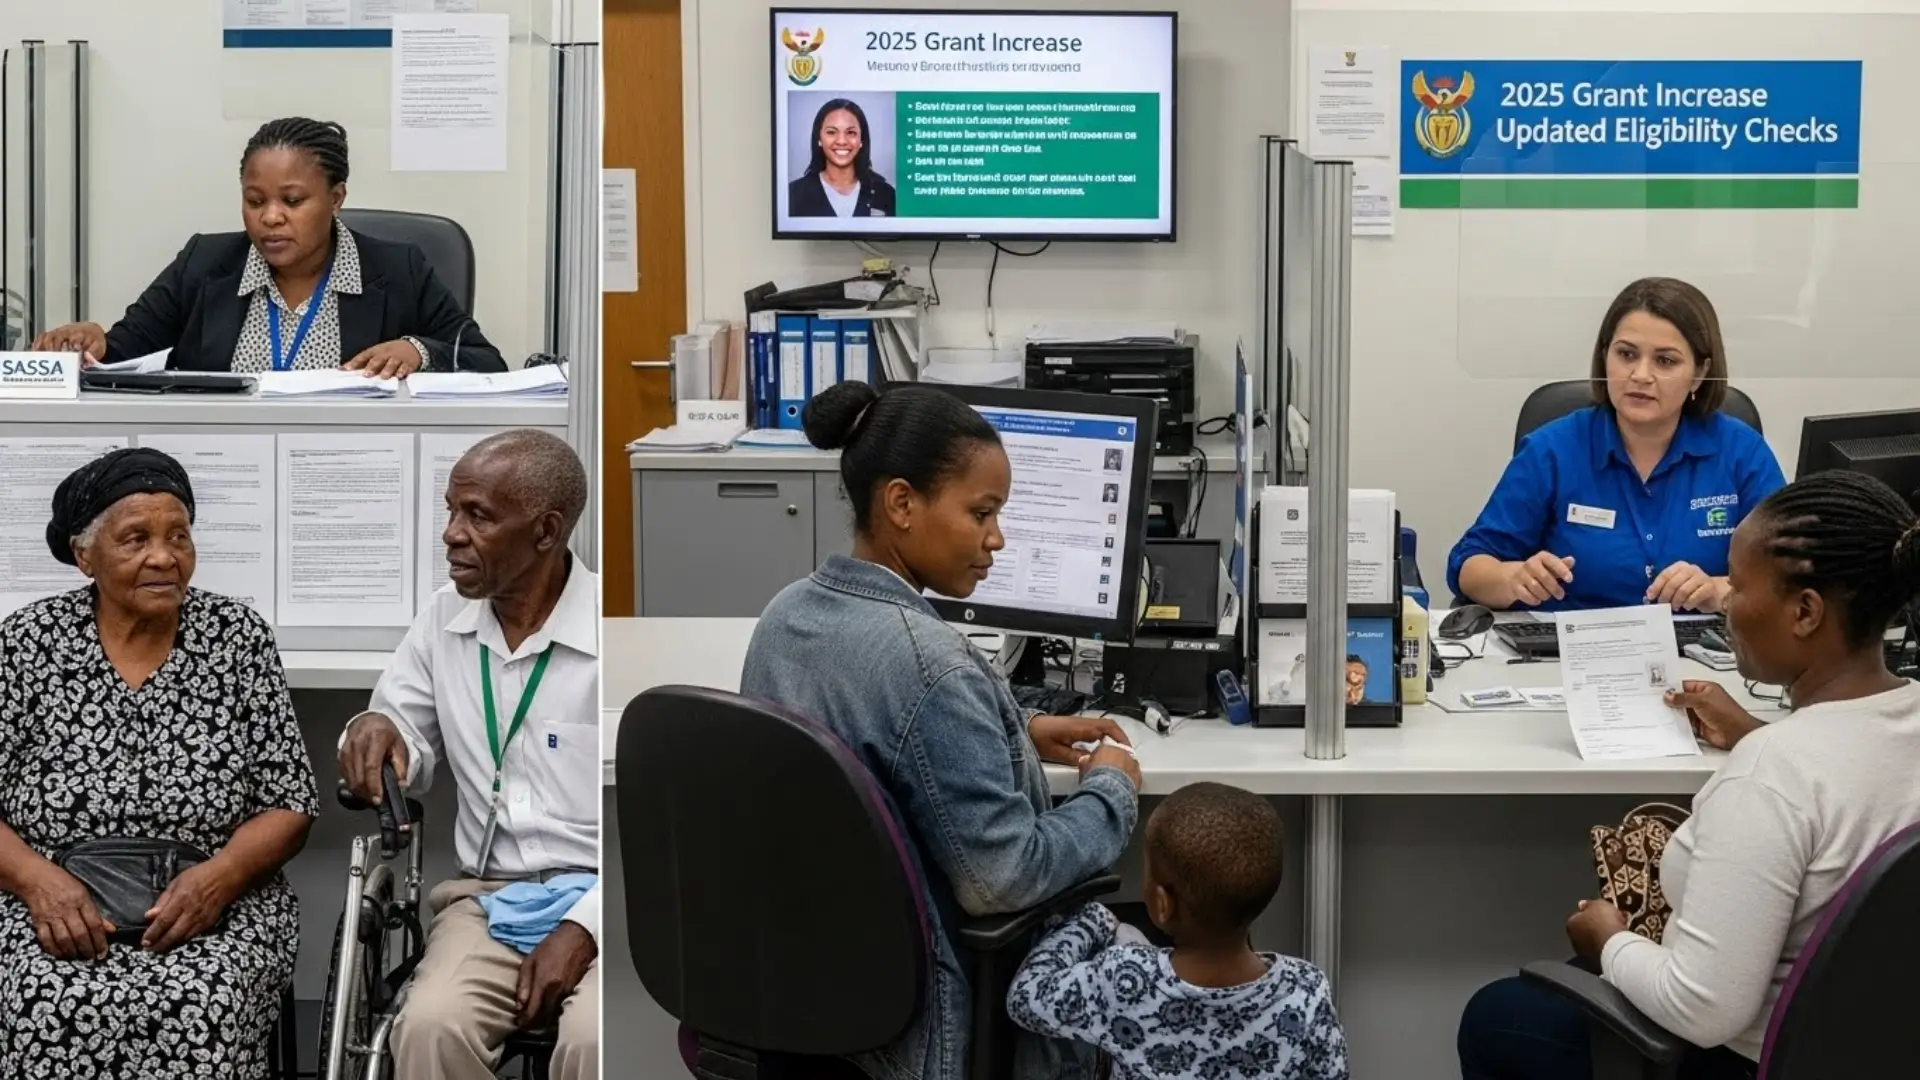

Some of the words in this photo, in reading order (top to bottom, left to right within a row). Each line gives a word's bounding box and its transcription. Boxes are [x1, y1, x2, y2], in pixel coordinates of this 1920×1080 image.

[865, 31, 917, 51] 2025
[924, 31, 986, 52] Grant
[993, 32, 1083, 53] Increase
[1500, 82, 1564, 107] 2025
[1572, 82, 1648, 107] Grant
[1656, 82, 1768, 107] Increase
[1497, 117, 1607, 150] Updated
[1615, 116, 1738, 150] Eligibility
[1745, 116, 1838, 144] Checks
[2, 359, 64, 376] SASSA
